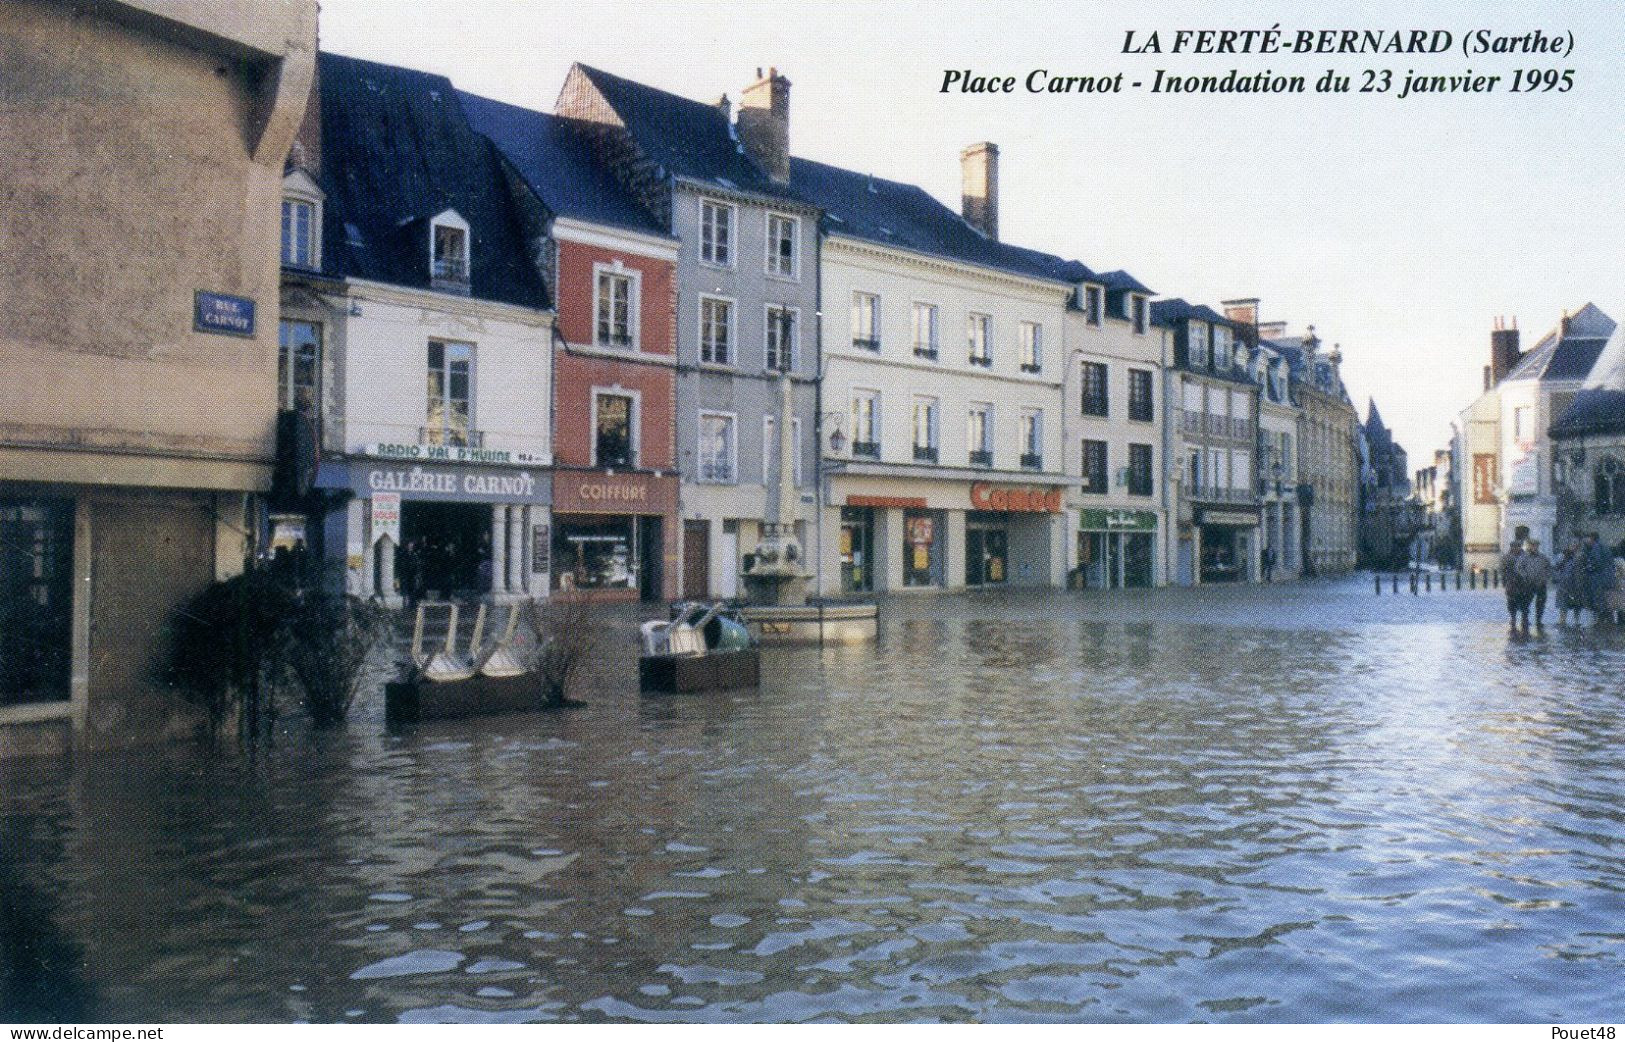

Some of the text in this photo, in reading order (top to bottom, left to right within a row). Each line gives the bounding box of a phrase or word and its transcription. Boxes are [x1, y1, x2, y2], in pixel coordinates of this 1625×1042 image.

[377, 442, 420, 458] RADIO
[428, 446, 449, 460] VAL
[463, 474, 536, 496] CARNOT
[580, 484, 648, 500] COIFFURE
